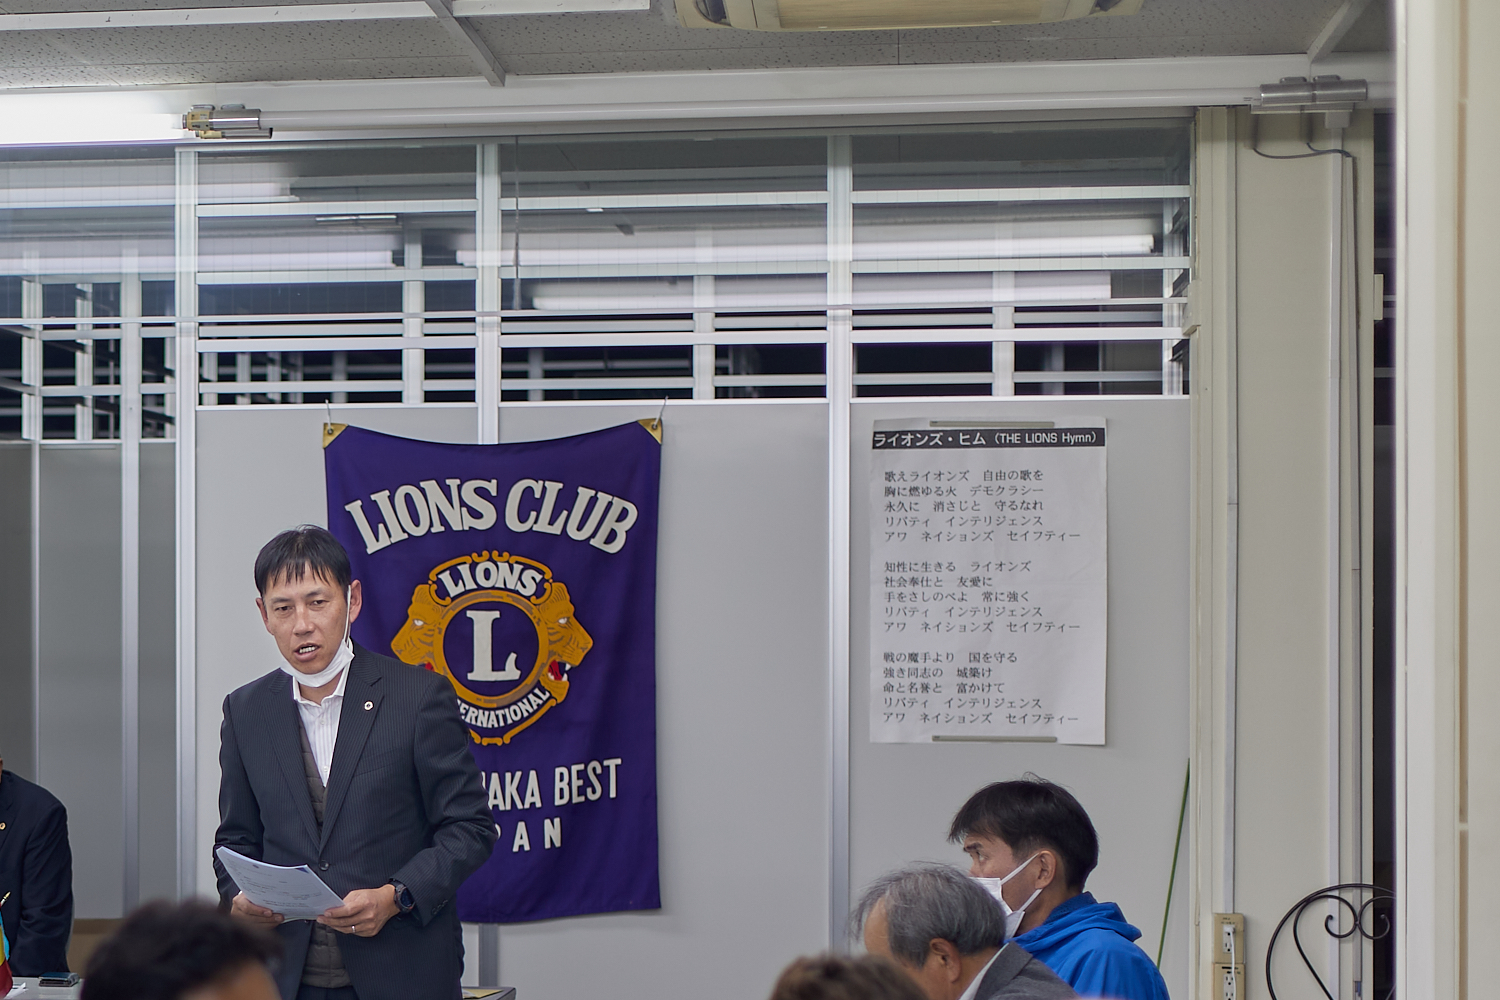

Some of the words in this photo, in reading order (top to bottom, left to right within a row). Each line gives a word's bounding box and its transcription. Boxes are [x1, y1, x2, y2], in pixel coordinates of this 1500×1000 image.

[1026, 431, 1058, 444] LIONS
[884, 469, 970, 483] 歌えライオンズ
[983, 469, 1044, 482] 自由の歌を
[883, 485, 958, 498] 胸に燃ゆる火
[969, 484, 1044, 497] デモクラシー
[884, 500, 920, 513] 永久に
[932, 500, 981, 513] 消さじと
[994, 499, 1044, 512] 守るなれ
[345, 478, 497, 555] LIONS
[505, 479, 638, 554] CLUB
[945, 515, 1043, 527] インテリジェンス
[884, 531, 908, 542] アワ
[921, 530, 995, 543] ネイションズ
[1006, 530, 1081, 542] セイフティー
[884, 560, 956, 573] 知性に生きる
[970, 560, 1032, 573] ライオンズ
[438, 561, 543, 598] LIONS
[884, 575, 943, 588] 社会奉仕と
[956, 575, 993, 589] 友愛に
[884, 591, 968, 603] 手をさしのべよ
[981, 590, 1029, 603] 常に強く
[945, 606, 1043, 618] インテリジェンス
[884, 621, 907, 632] アワ
[921, 620, 994, 633] ネイションズ
[1006, 621, 1080, 633] セイフティー
[466, 610, 521, 681] L
[883, 651, 955, 664] 戦の魔手より
[968, 651, 1018, 664] 国を守る
[882, 666, 944, 679] 強き同志の
[956, 666, 993, 679] 城築け
[882, 681, 942, 694] 命と名誉と
[955, 681, 1005, 695] 富かけて
[457, 687, 550, 728] ERNATIONAL
[944, 697, 1042, 709] インテリジェンス
[883, 712, 906, 723] アワ
[919, 712, 993, 724] ネイションズ
[1005, 713, 1079, 725] セイフティー
[481, 770, 542, 811] AKA
[554, 758, 622, 806] BEST
